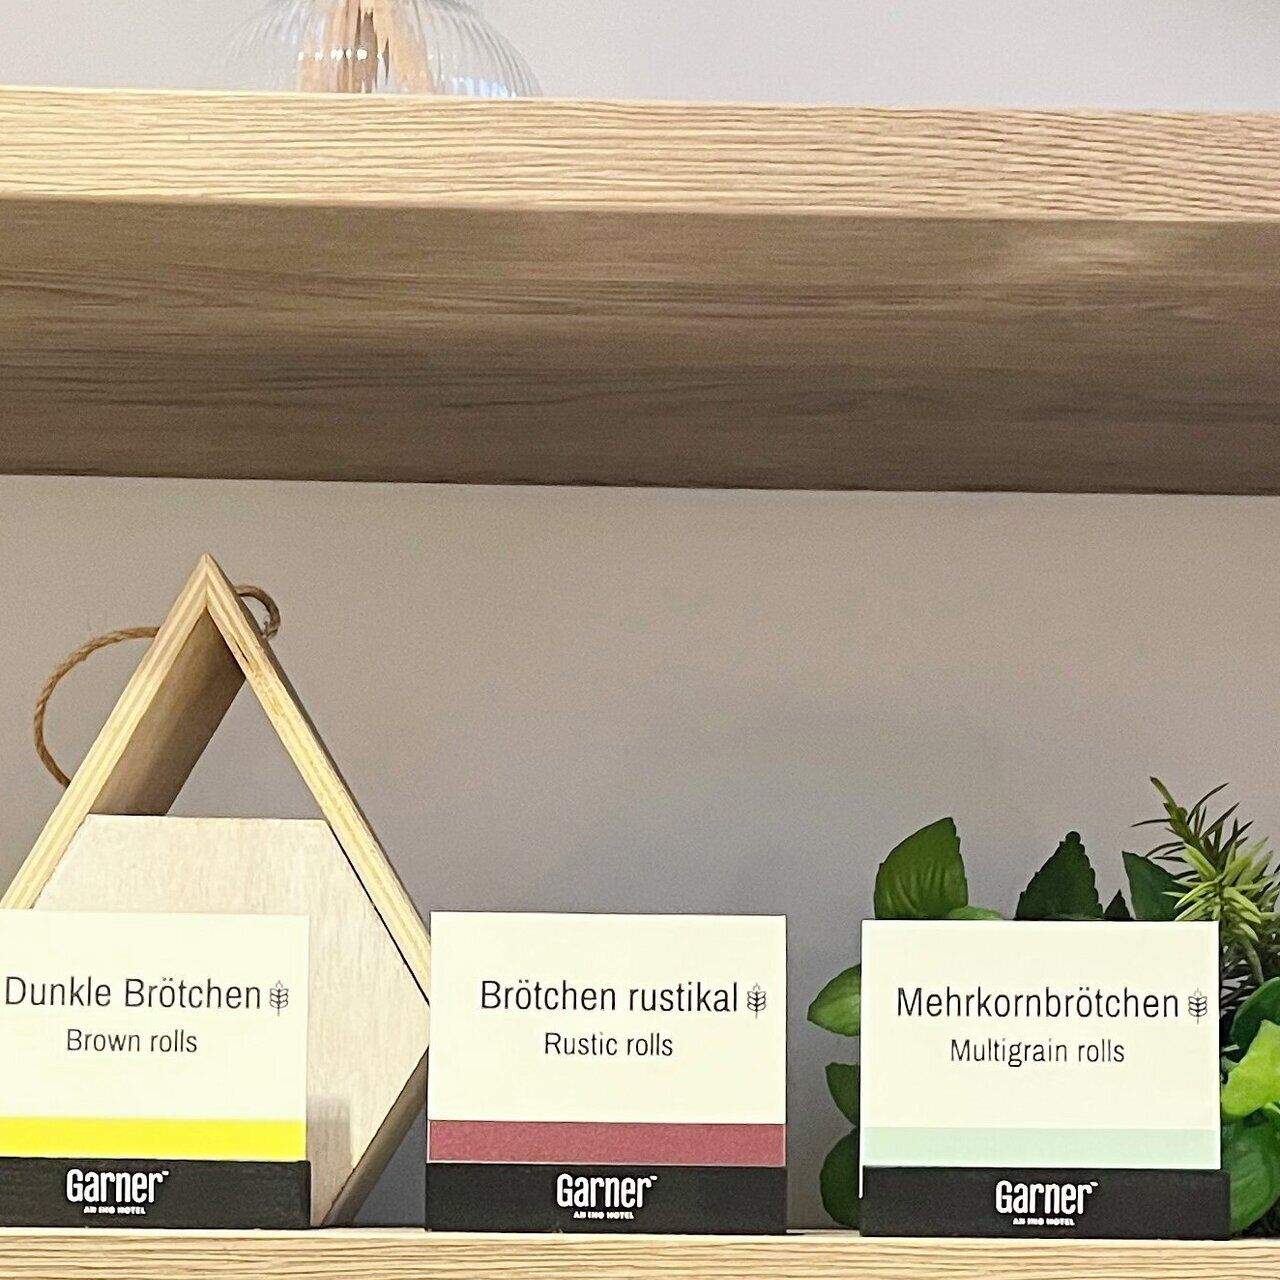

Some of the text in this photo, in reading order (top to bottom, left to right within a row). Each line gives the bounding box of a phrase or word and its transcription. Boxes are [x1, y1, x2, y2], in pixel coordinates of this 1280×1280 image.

[4, 975, 261, 1009] Dunkle Brötchen
[480, 979, 738, 1012] Brötchen rustikal
[897, 986, 1179, 1018] Mehrkornbrötchen
[66, 1028, 198, 1053] Brown rolls
[544, 1032, 674, 1056] Rustic rolls
[950, 1038, 1125, 1067] Multigrain rolls
[66, 1168, 164, 1203] Garner
[556, 1173, 652, 1208] Garner
[995, 1180, 1093, 1214] Garner
[117, 1206, 146, 1214] HOTEL
[606, 1211, 634, 1219] HOTEL
[1046, 1217, 1075, 1226] HOTEL
